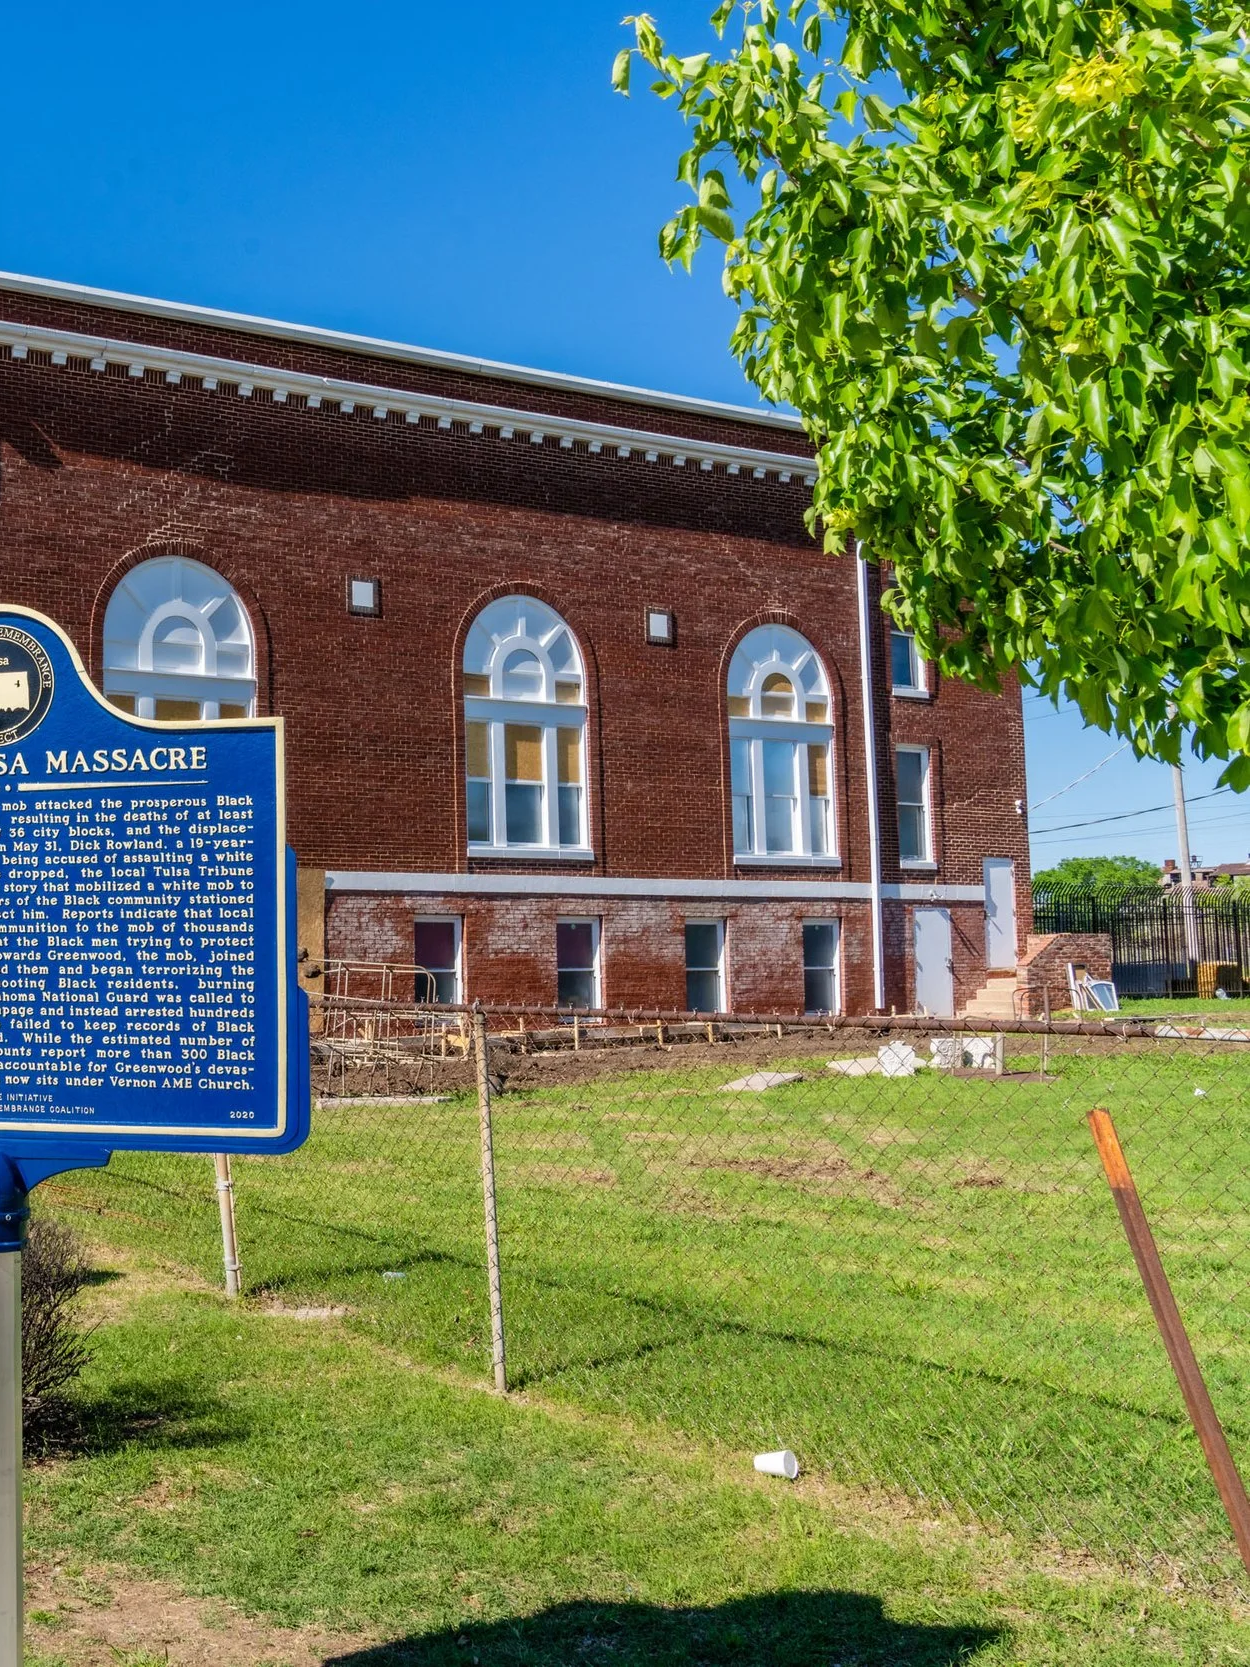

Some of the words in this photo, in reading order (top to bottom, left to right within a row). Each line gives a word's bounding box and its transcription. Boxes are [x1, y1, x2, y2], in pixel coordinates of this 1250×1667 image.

[46, 746, 208, 774] MASSACRE
[9, 827, 25, 837] 36
[32, 826, 60, 838] city
[68, 826, 114, 836] blocks,
[126, 824, 150, 835] and
[157, 824, 180, 834] the
[188, 823, 254, 835] displace-
[2, 854, 38, 867] being
[44, 854, 98, 864] accused
[103, 853, 117, 863] of
[123, 852, 192, 864] assaulting
[200, 853, 208, 862] a
[215, 851, 253, 861] white
[3, 882, 37, 894] story
[42, 882, 69, 892] that
[74, 880, 140, 891] mobilized
[147, 882, 154, 890] a
[162, 879, 200, 890] white
[206, 879, 234, 890] mob
[240, 880, 254, 889] to
[22, 908, 48, 919] him.
[62, 908, 113, 921] Reports
[120, 908, 177, 918] indicate
[183, 908, 212, 918] that
[219, 907, 254, 918] local
[16, 936, 38, 946] the
[47, 935, 84, 946] Black
[91, 938, 118, 946] men
[126, 935, 171, 949] trying
[179, 936, 193, 946] to
[200, 936, 254, 948] protect
[16, 964, 49, 974] them
[59, 964, 83, 974] and
[91, 964, 133, 977] began
[141, 964, 222, 978] terrorizing
[231, 965, 254, 975] the
[42, 991, 99, 1002] National
[106, 992, 148, 1002] Guard
[155, 994, 182, 1003] was
[189, 992, 233, 1003] called
[240, 993, 254, 1003] to
[10, 1018, 50, 1029] failed
[60, 1019, 74, 1029] to
[84, 1019, 116, 1032] keep
[126, 1021, 180, 1031] records
[192, 1020, 206, 1031] of
[216, 1021, 254, 1032] Black
[40, 1047, 86, 1059] report
[96, 1049, 130, 1058] more
[140, 1048, 172, 1059] than
[181, 1048, 207, 1059] 300
[216, 1049, 255, 1060] Black
[4, 1075, 30, 1084] now
[36, 1075, 58, 1085] sits
[65, 1075, 104, 1086] under
[109, 1076, 156, 1088] Vernon
[161, 1077, 192, 1088] AME
[198, 1078, 254, 1090] Church.
[7, 1094, 53, 1102] INITIATIVE
[50, 1105, 95, 1114] COALITION
[230, 1111, 255, 1119] 2020
